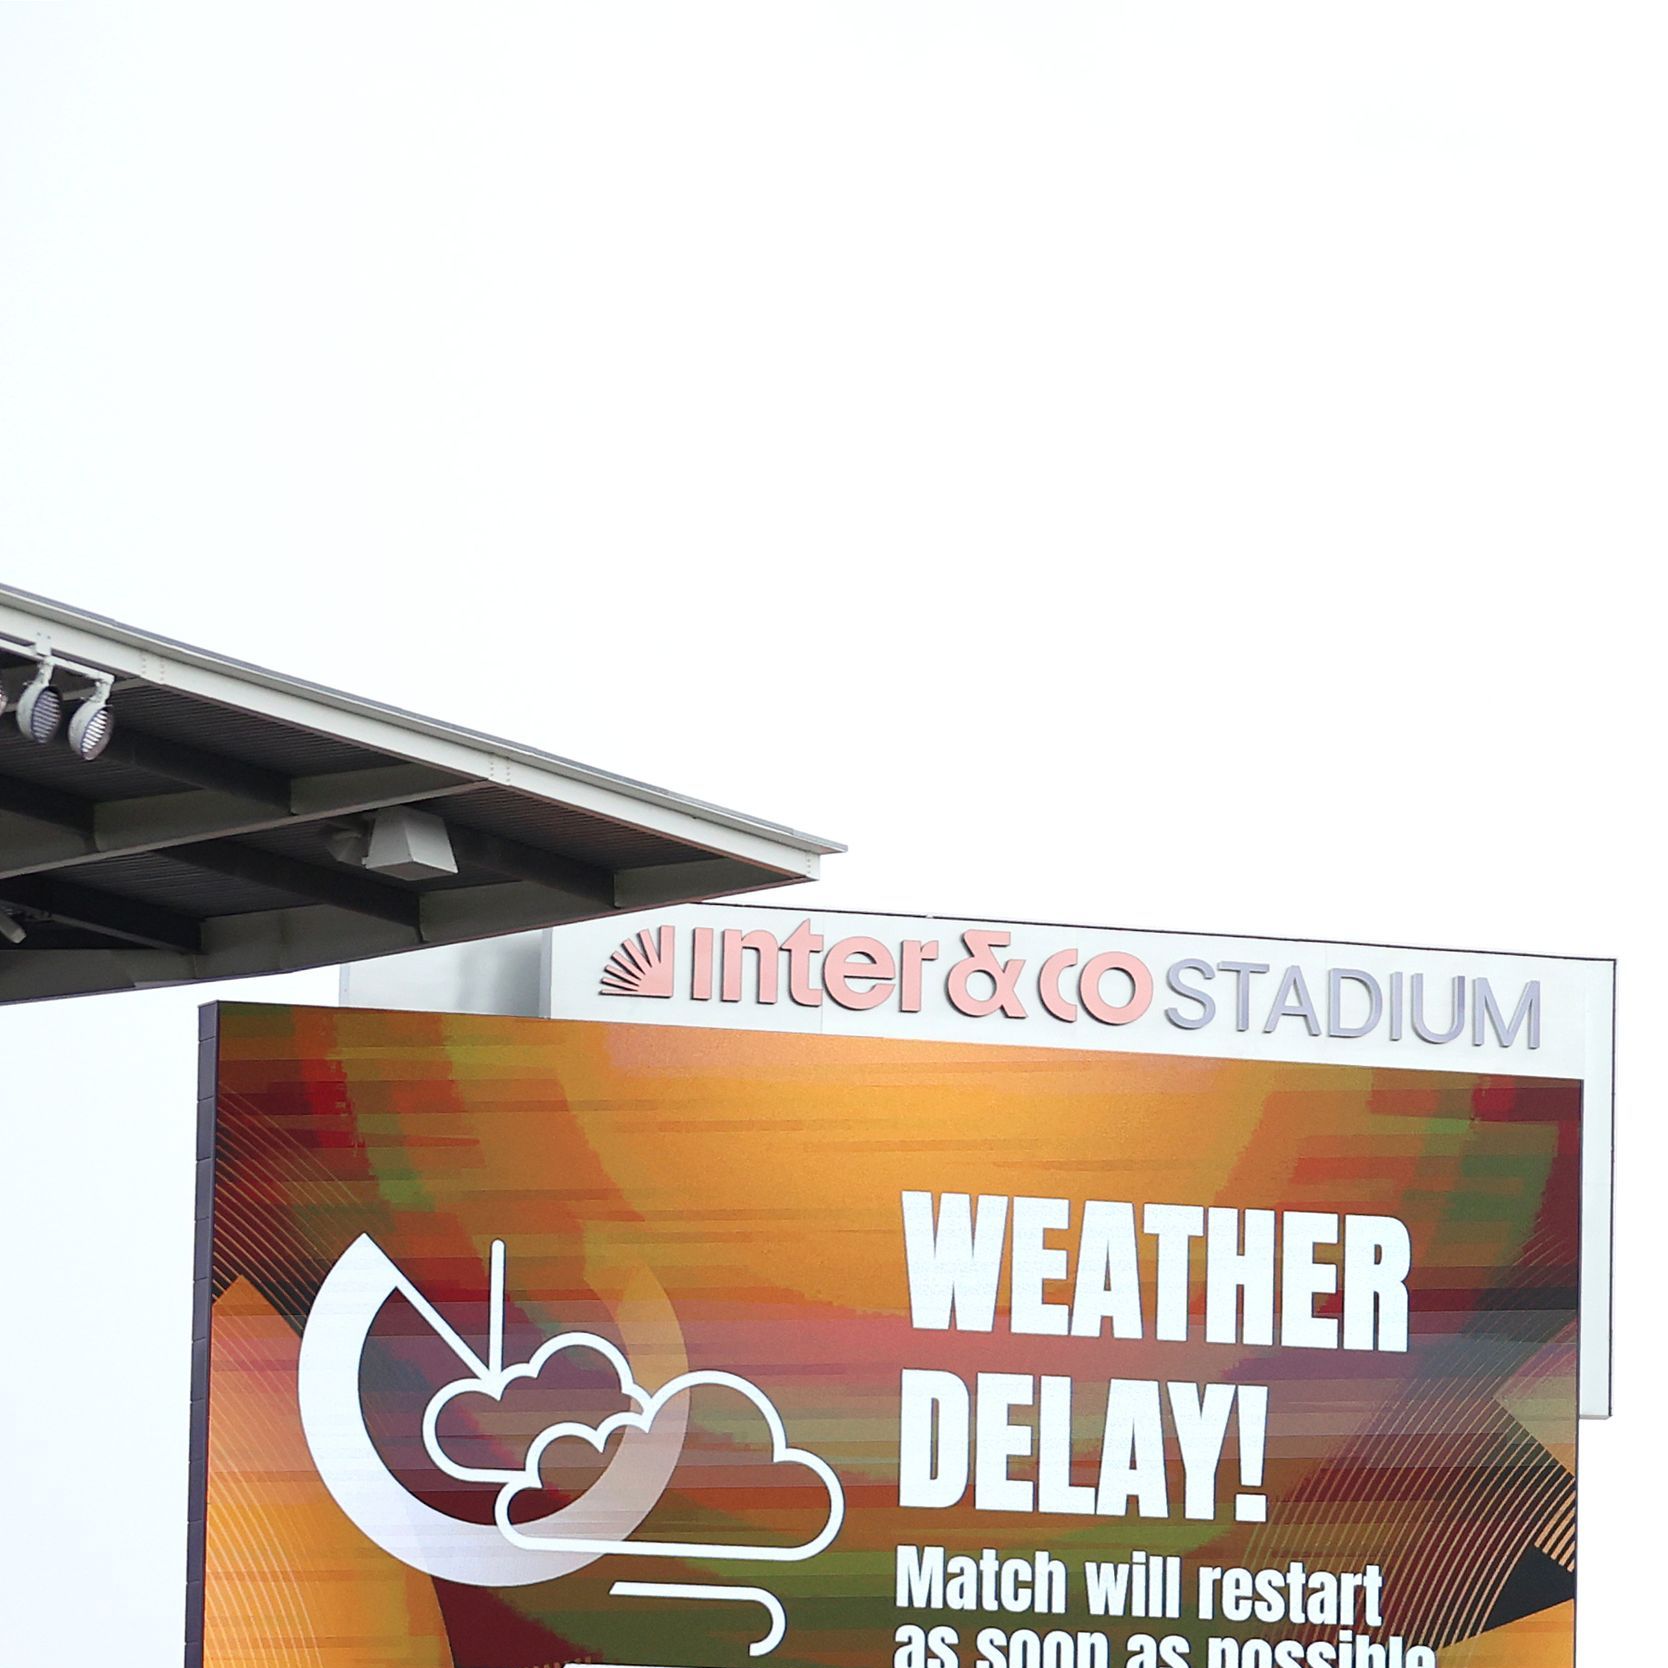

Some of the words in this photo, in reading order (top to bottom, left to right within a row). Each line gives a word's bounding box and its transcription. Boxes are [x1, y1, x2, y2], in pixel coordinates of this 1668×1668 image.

[1166, 956, 1543, 1050] STADIUM
[901, 1190, 1412, 1353] WEATHER
[898, 1368, 1268, 1523] DELAY!
[896, 1545, 1067, 1614] Match
[1085, 1551, 1181, 1619] will
[1197, 1562, 1382, 1626] restart
